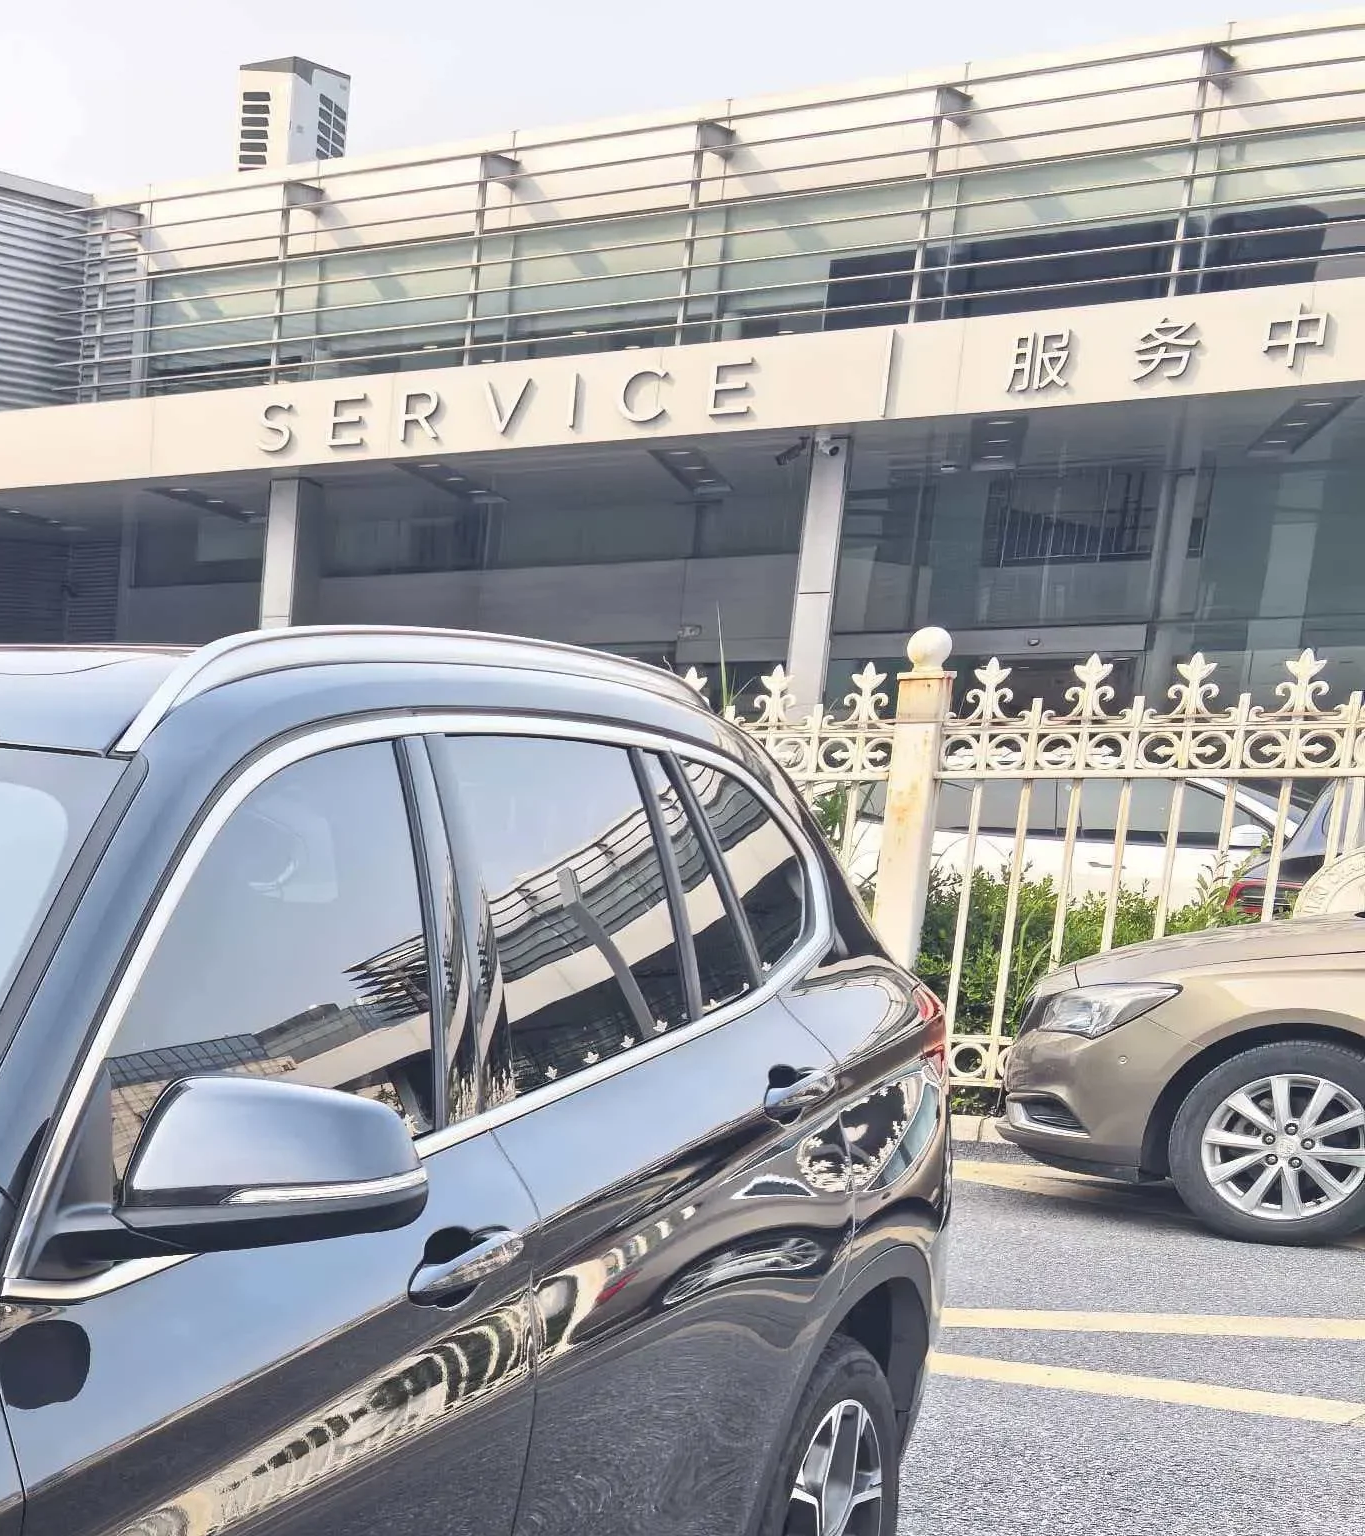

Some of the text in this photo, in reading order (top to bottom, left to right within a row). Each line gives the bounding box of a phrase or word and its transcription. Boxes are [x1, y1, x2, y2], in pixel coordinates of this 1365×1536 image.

[1005, 302, 1330, 393] 服务中
[257, 356, 757, 454] SERVICE
